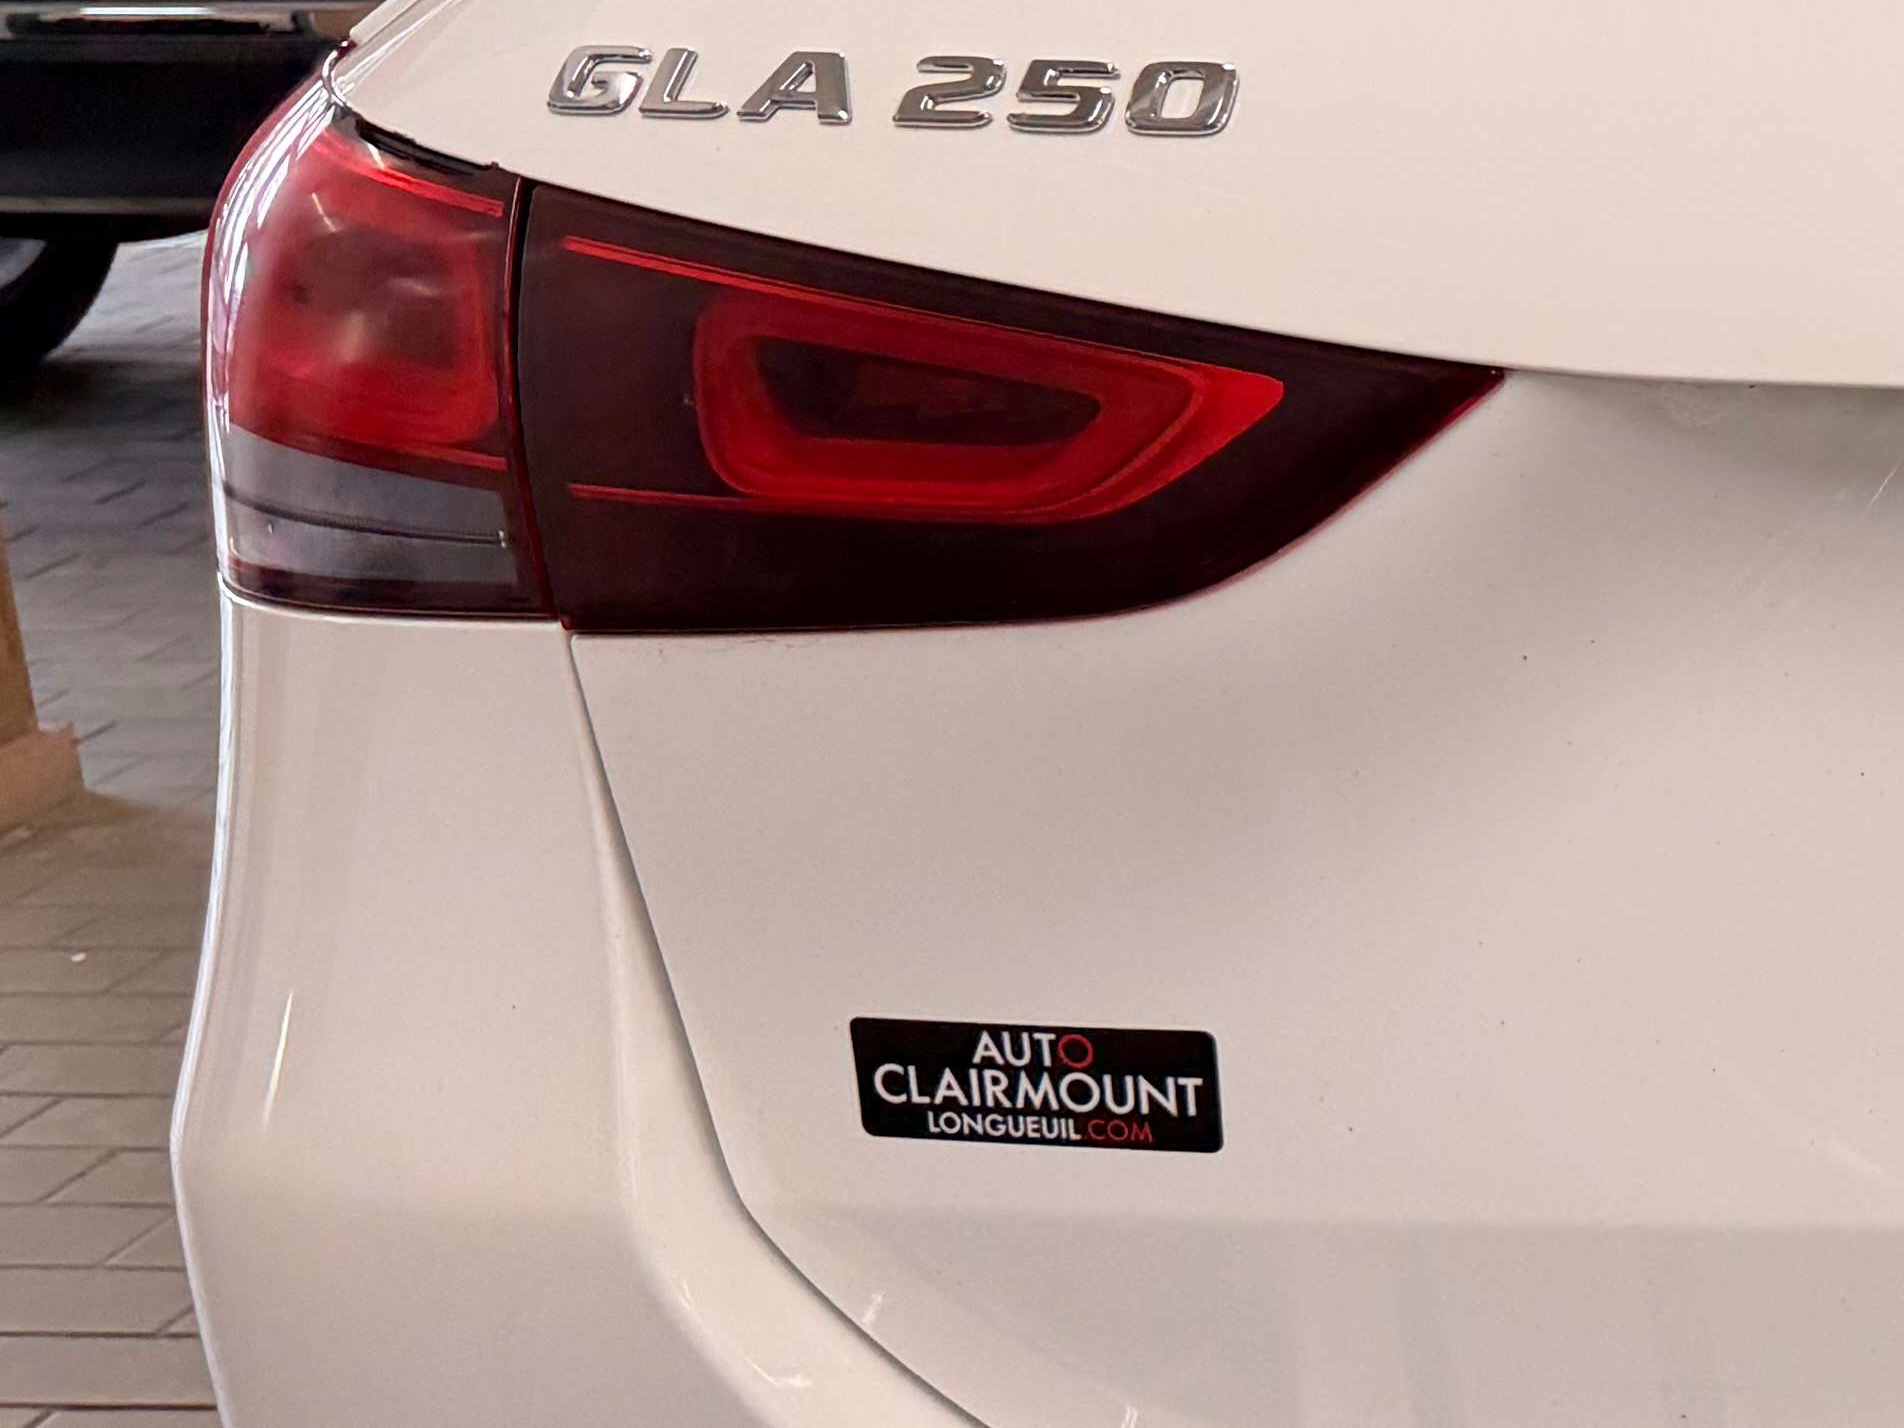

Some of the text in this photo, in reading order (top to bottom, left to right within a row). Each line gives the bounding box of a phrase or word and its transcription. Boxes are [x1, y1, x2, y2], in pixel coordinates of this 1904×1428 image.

[546, 44, 1242, 139] GLA 250
[972, 1029, 1094, 1069] AUTO
[873, 1062, 1204, 1118] CLAIRMOUNT
[927, 1110, 1154, 1144] LONGUEUIL.COM
